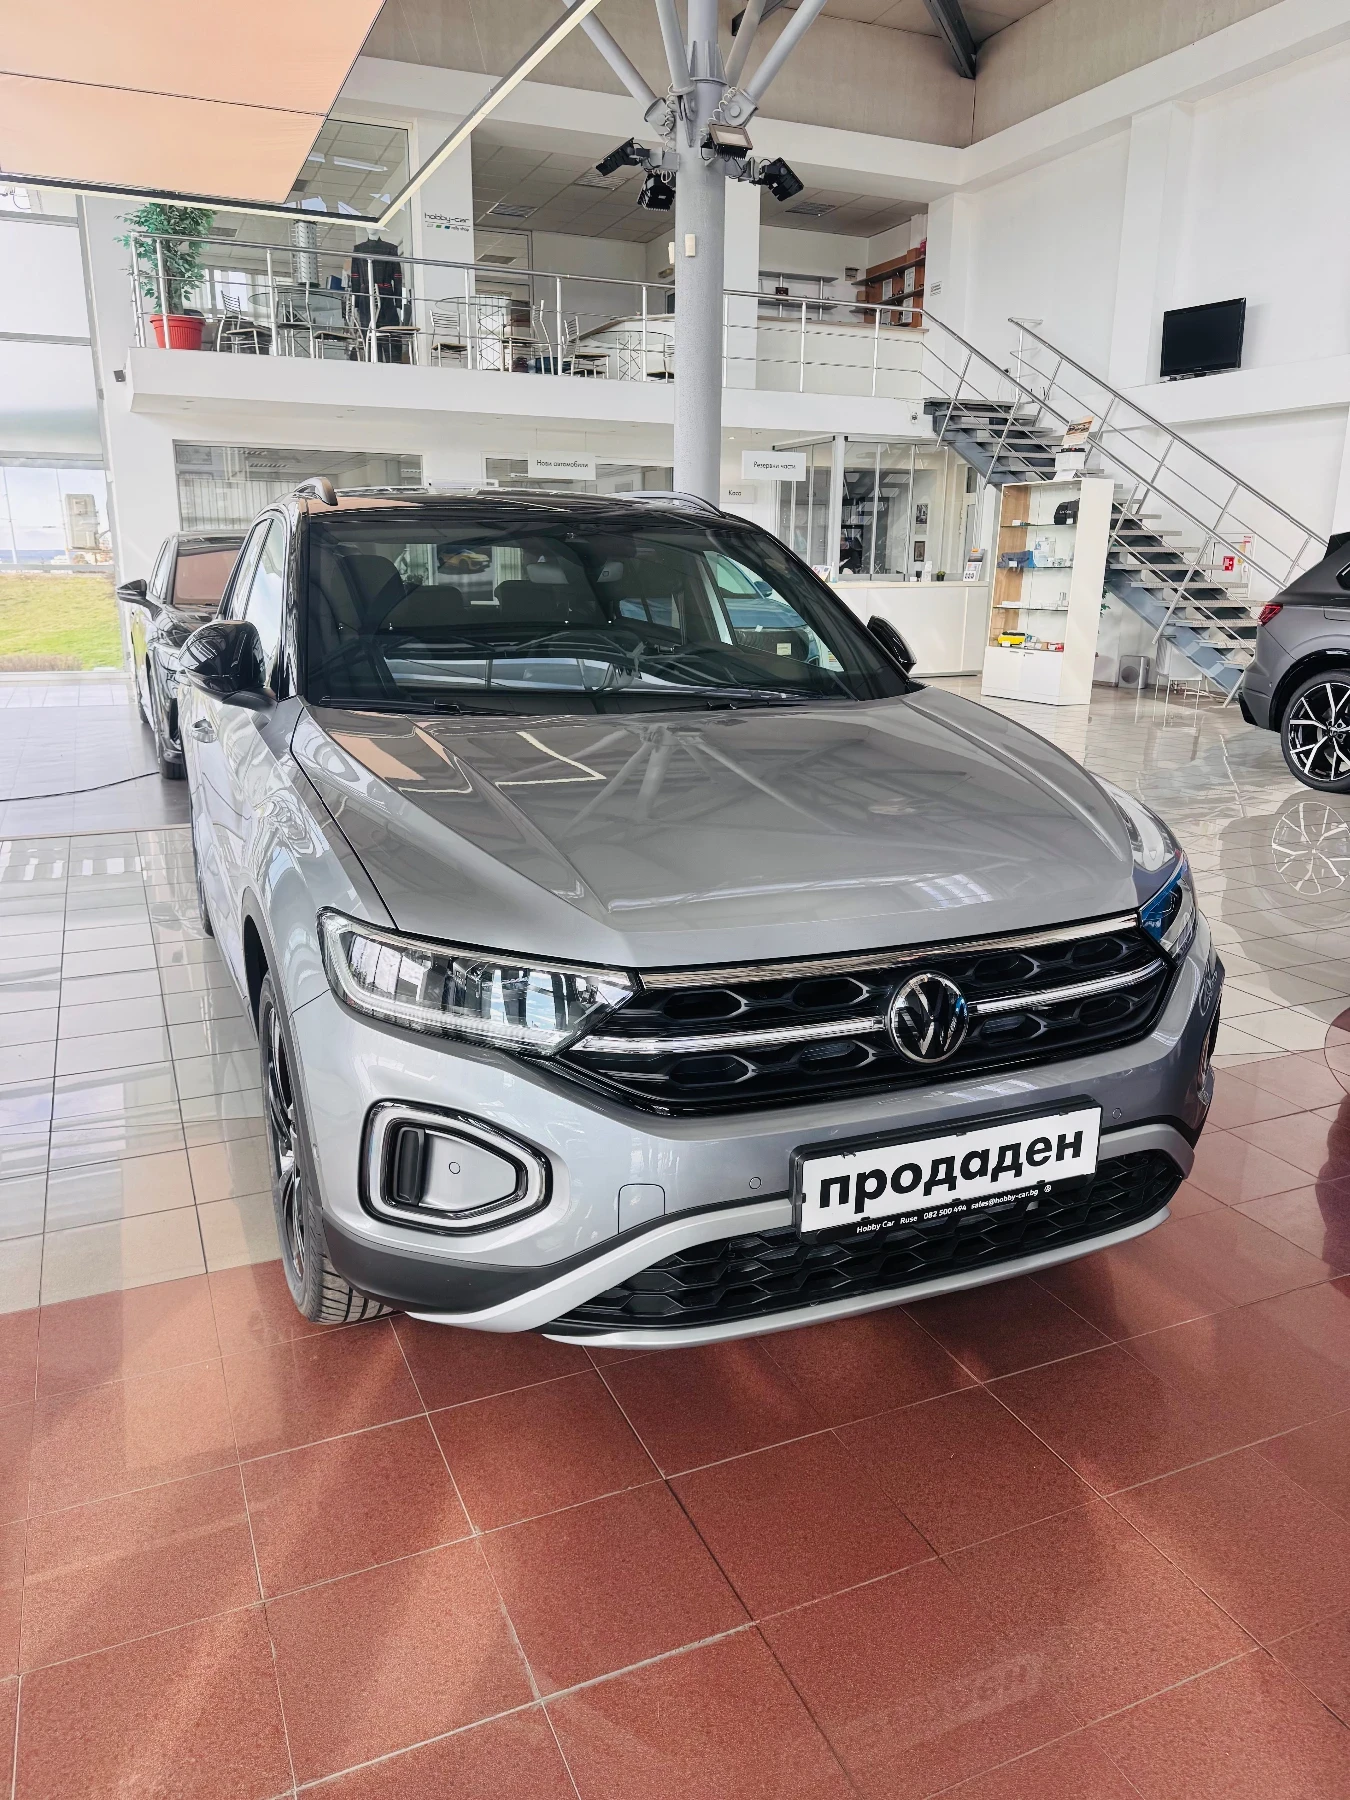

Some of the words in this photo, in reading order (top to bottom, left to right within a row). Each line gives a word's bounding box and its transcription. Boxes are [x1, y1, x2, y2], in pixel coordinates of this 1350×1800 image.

[424, 212, 470, 223] hobby-car
[536, 459, 552, 467] Нови
[553, 460, 589, 468] автомобили
[819, 1130, 1084, 1214] продаден
[856, 1222, 881, 1234] Hobby
[882, 1220, 895, 1228] Car
[900, 1216, 918, 1225] Ruse
[923, 1210, 938, 1220] 082
[938, 1207, 953, 1217] 500
[953, 1204, 967, 1213] 494
[970, 1188, 1039, 1210] sales@hobby-car.bg
